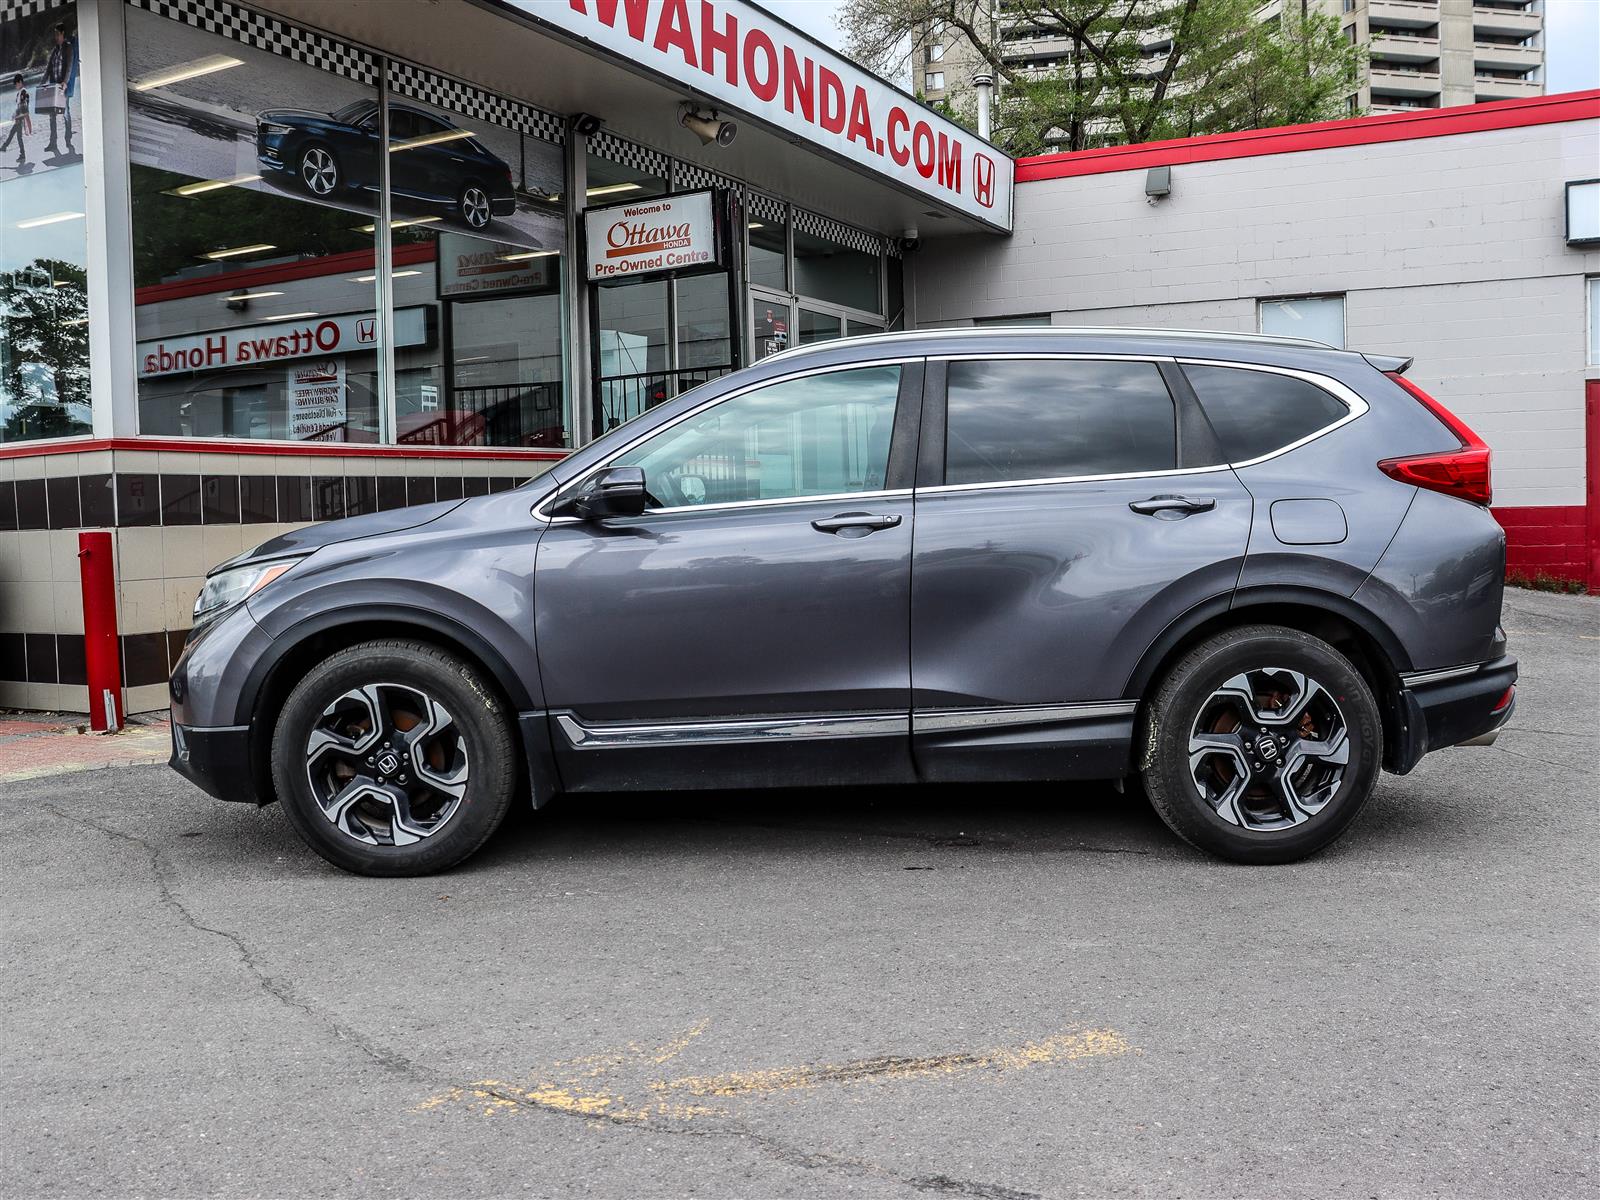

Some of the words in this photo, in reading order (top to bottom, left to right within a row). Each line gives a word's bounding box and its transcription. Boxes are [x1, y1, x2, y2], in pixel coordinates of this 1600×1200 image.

[623, 204, 661, 217] Welcome
[662, 203, 671, 211] to
[607, 220, 691, 248] Ottawa
[663, 239, 689, 249] HONDA
[595, 255, 662, 276] Pre-Owned
[666, 250, 709, 265] Centre
